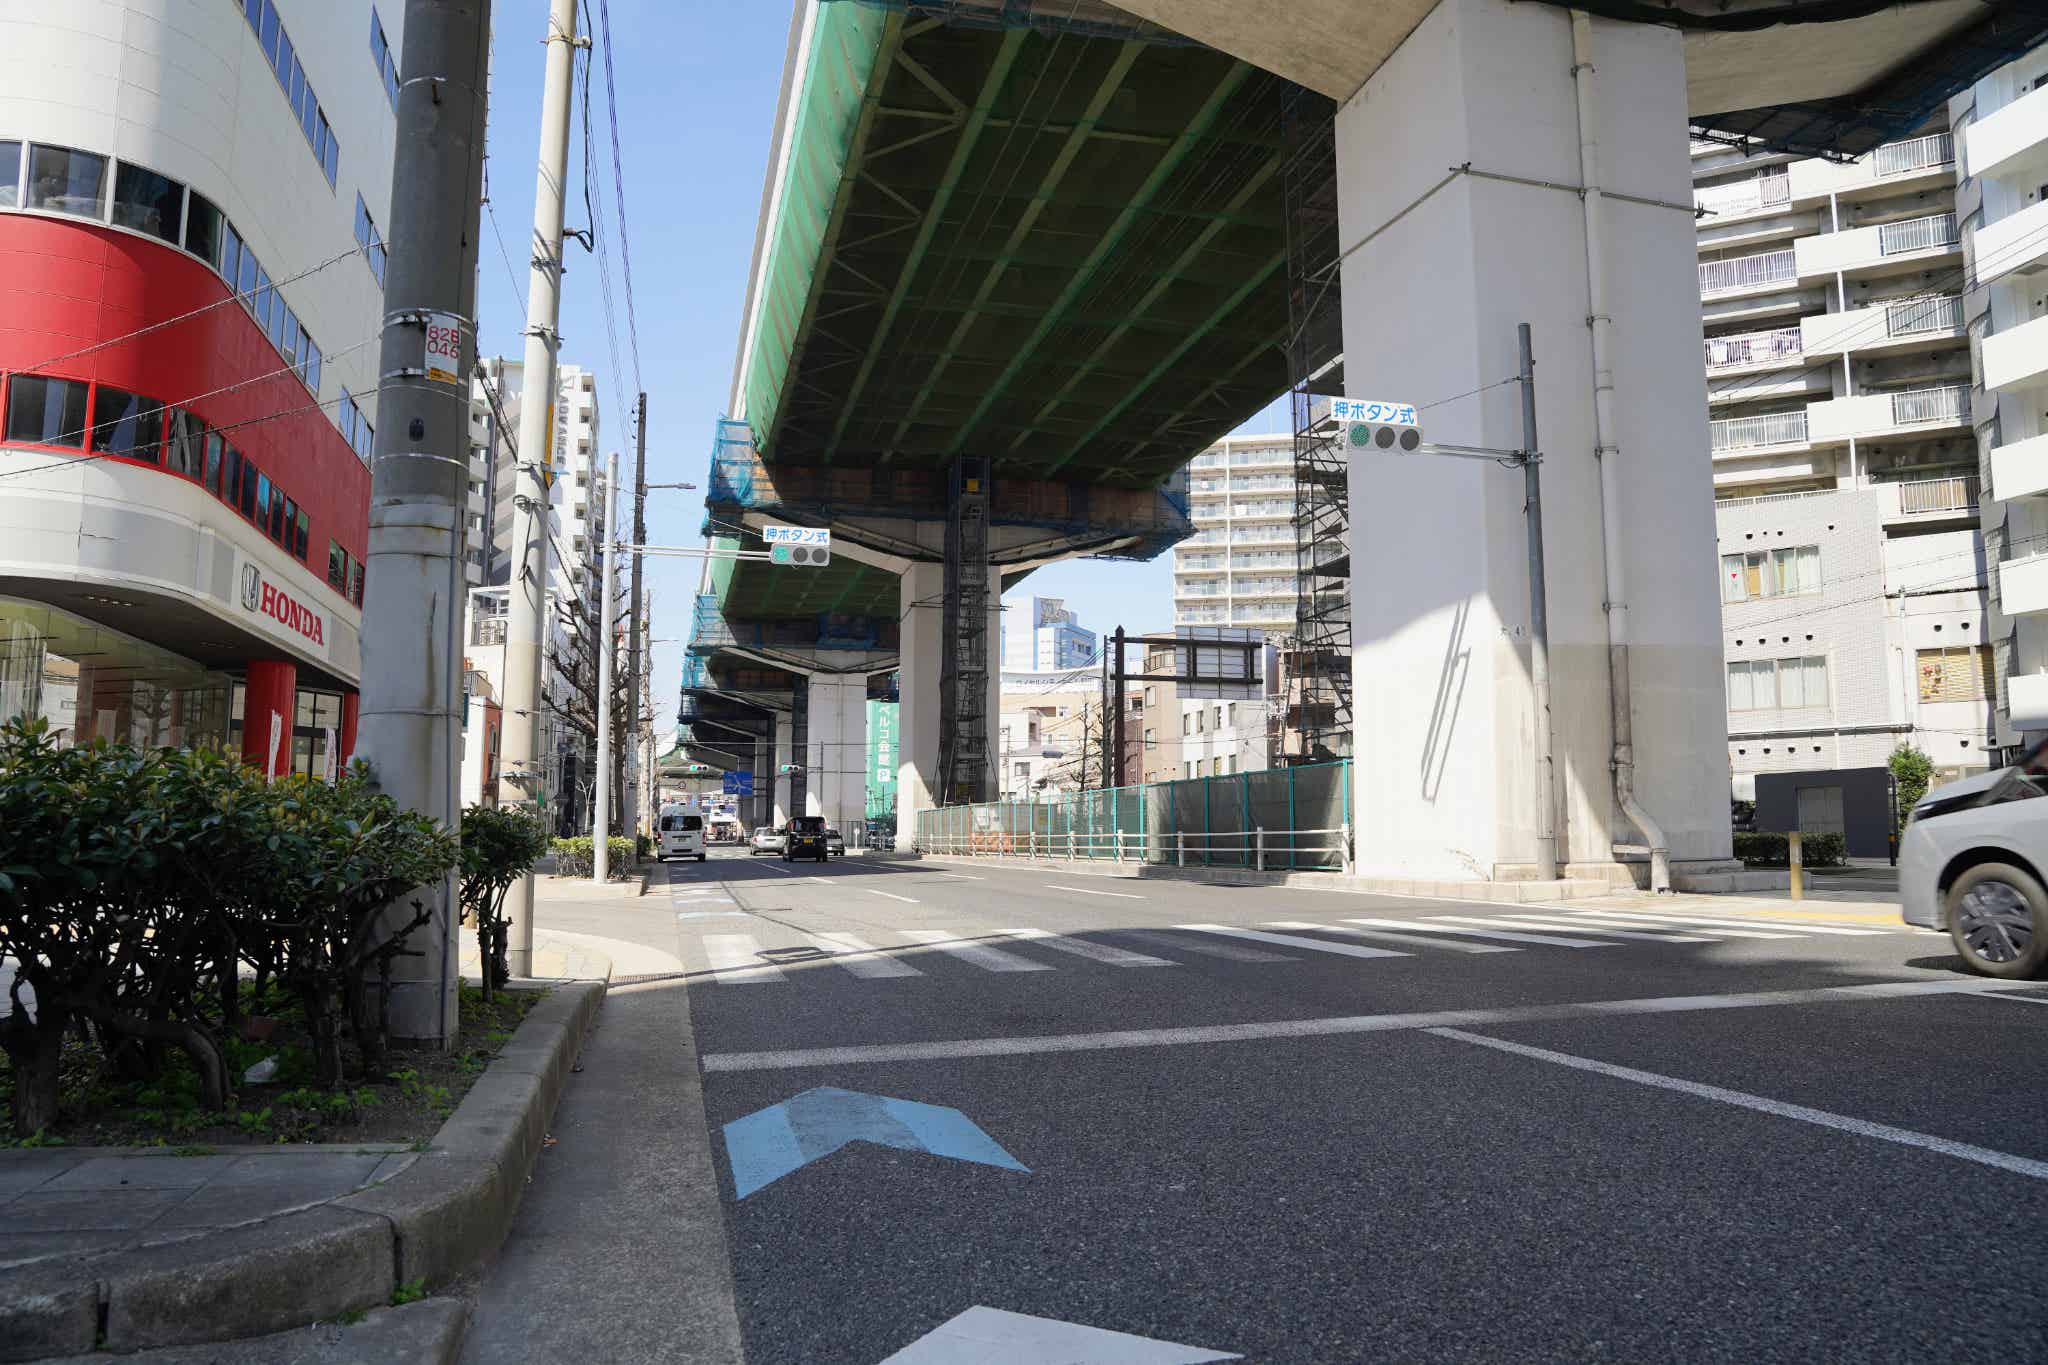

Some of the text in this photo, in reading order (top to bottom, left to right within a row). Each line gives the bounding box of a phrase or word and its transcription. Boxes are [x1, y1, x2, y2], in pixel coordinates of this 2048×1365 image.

[427, 341, 459, 359] 046
[1334, 400, 1415, 424] 押ボタン式
[766, 527, 828, 544] 押ボタン式
[260, 581, 324, 646] HONDA
